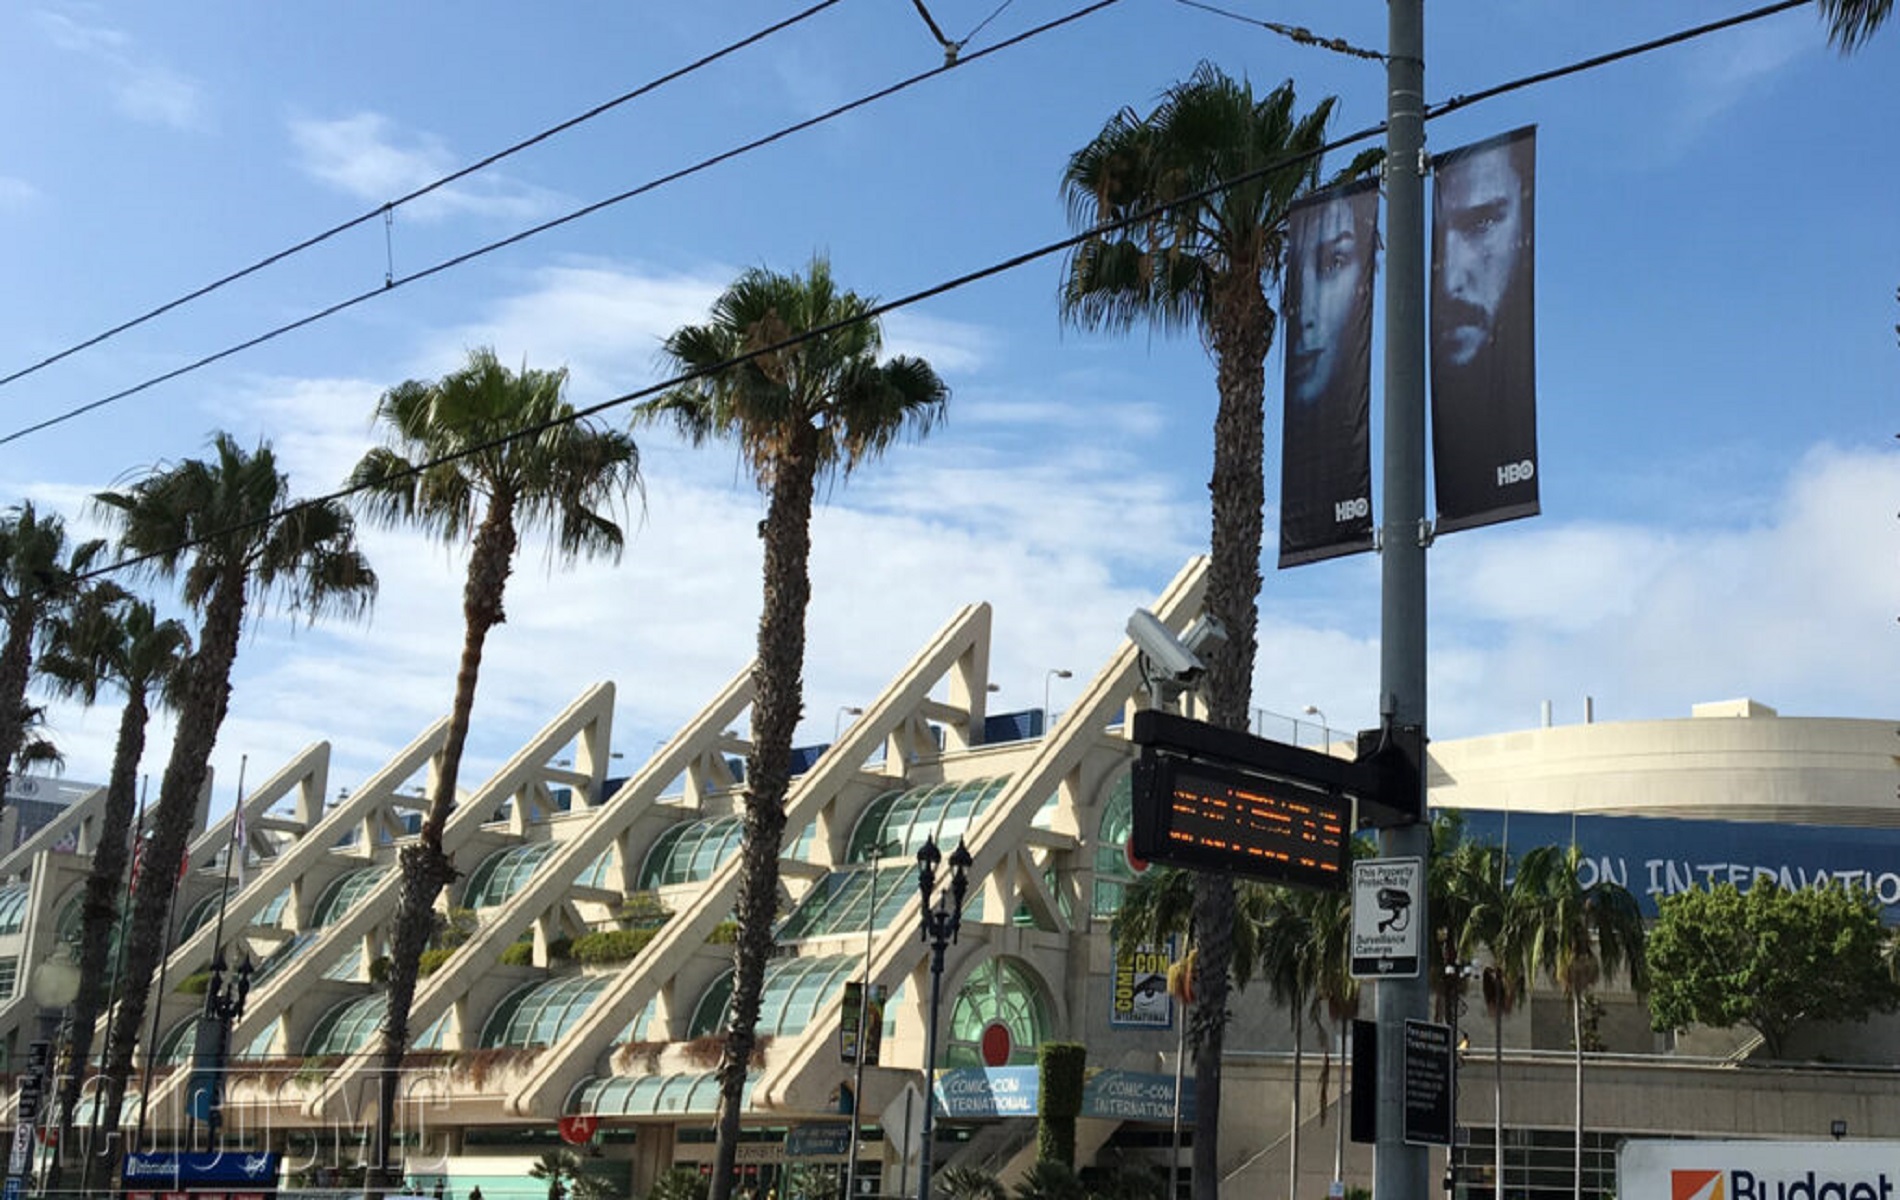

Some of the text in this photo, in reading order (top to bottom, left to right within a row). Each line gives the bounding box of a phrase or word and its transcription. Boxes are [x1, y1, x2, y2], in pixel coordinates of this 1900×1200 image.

[1497, 459, 1535, 486] HBO
[1335, 498, 1369, 522] HBO
[1359, 866, 1413, 877] This Property
[1358, 877, 1398, 886] Protected
[1356, 935, 1406, 945] Surveillance
[1356, 946, 1393, 955] Cameras
[1135, 953, 1168, 974] CON
[951, 1077, 1020, 1094] COMIC-CON
[1109, 1081, 1174, 1100] COMIC-CON
[1095, 1098, 1185, 1118] INTERNATION
[570, 1117, 589, 1133] A
